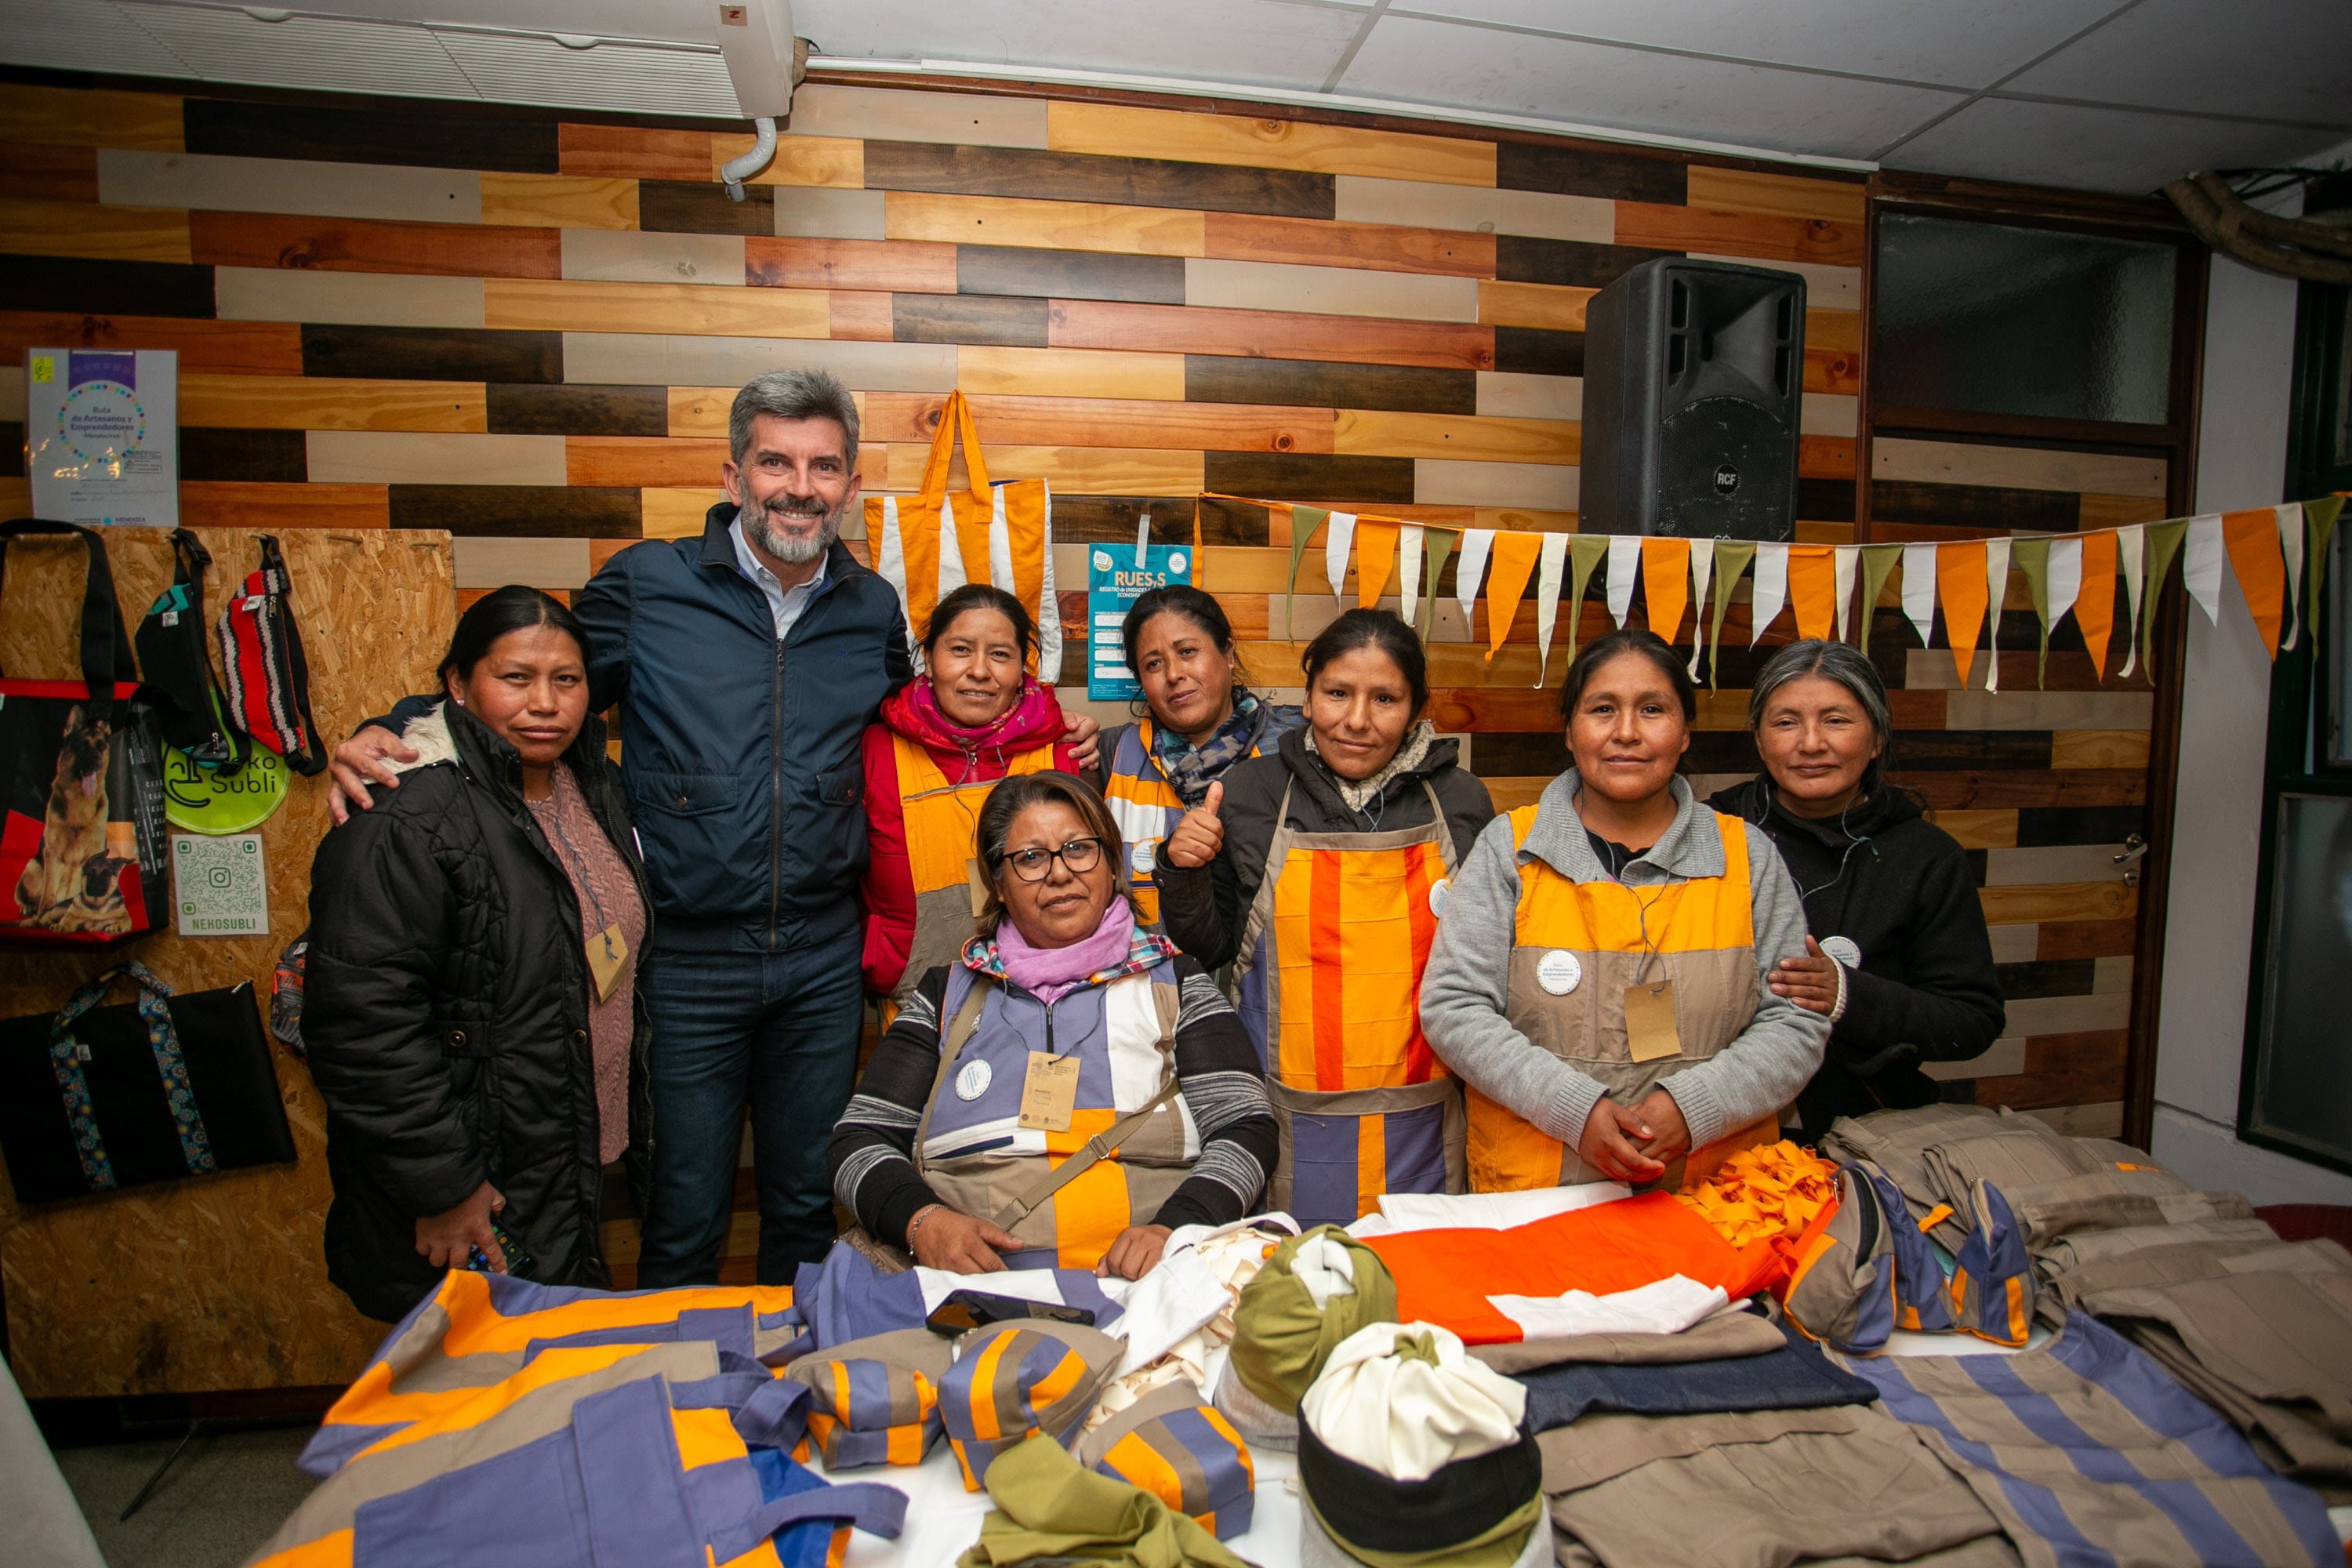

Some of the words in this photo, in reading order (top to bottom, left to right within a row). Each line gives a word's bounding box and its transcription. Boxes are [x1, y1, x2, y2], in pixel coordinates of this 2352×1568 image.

[1717, 473, 1737, 485] RCF
[211, 771, 276, 793] Subli
[192, 918, 256, 930] NEKOSUBLI
